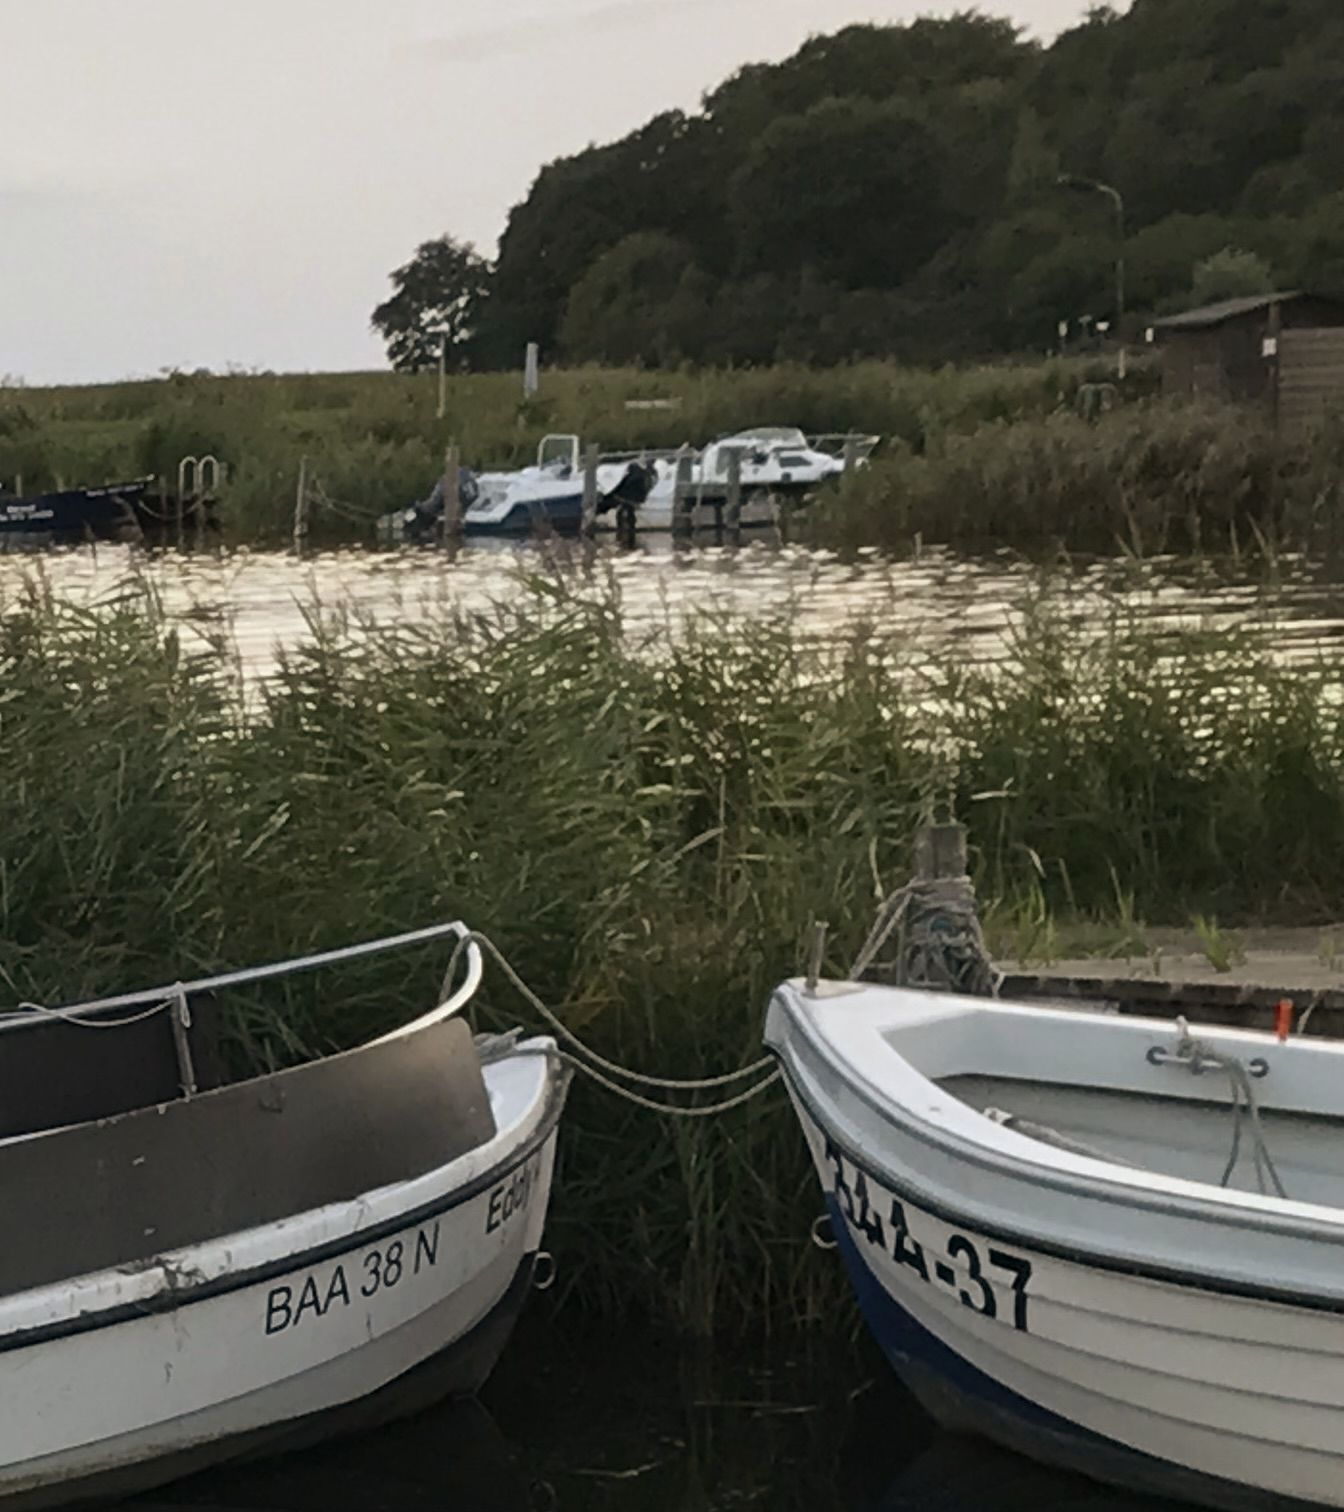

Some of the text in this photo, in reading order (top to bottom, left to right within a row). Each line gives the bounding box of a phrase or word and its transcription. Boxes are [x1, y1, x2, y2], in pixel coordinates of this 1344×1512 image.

[265, 1220, 440, 1336] BAA 38 N
